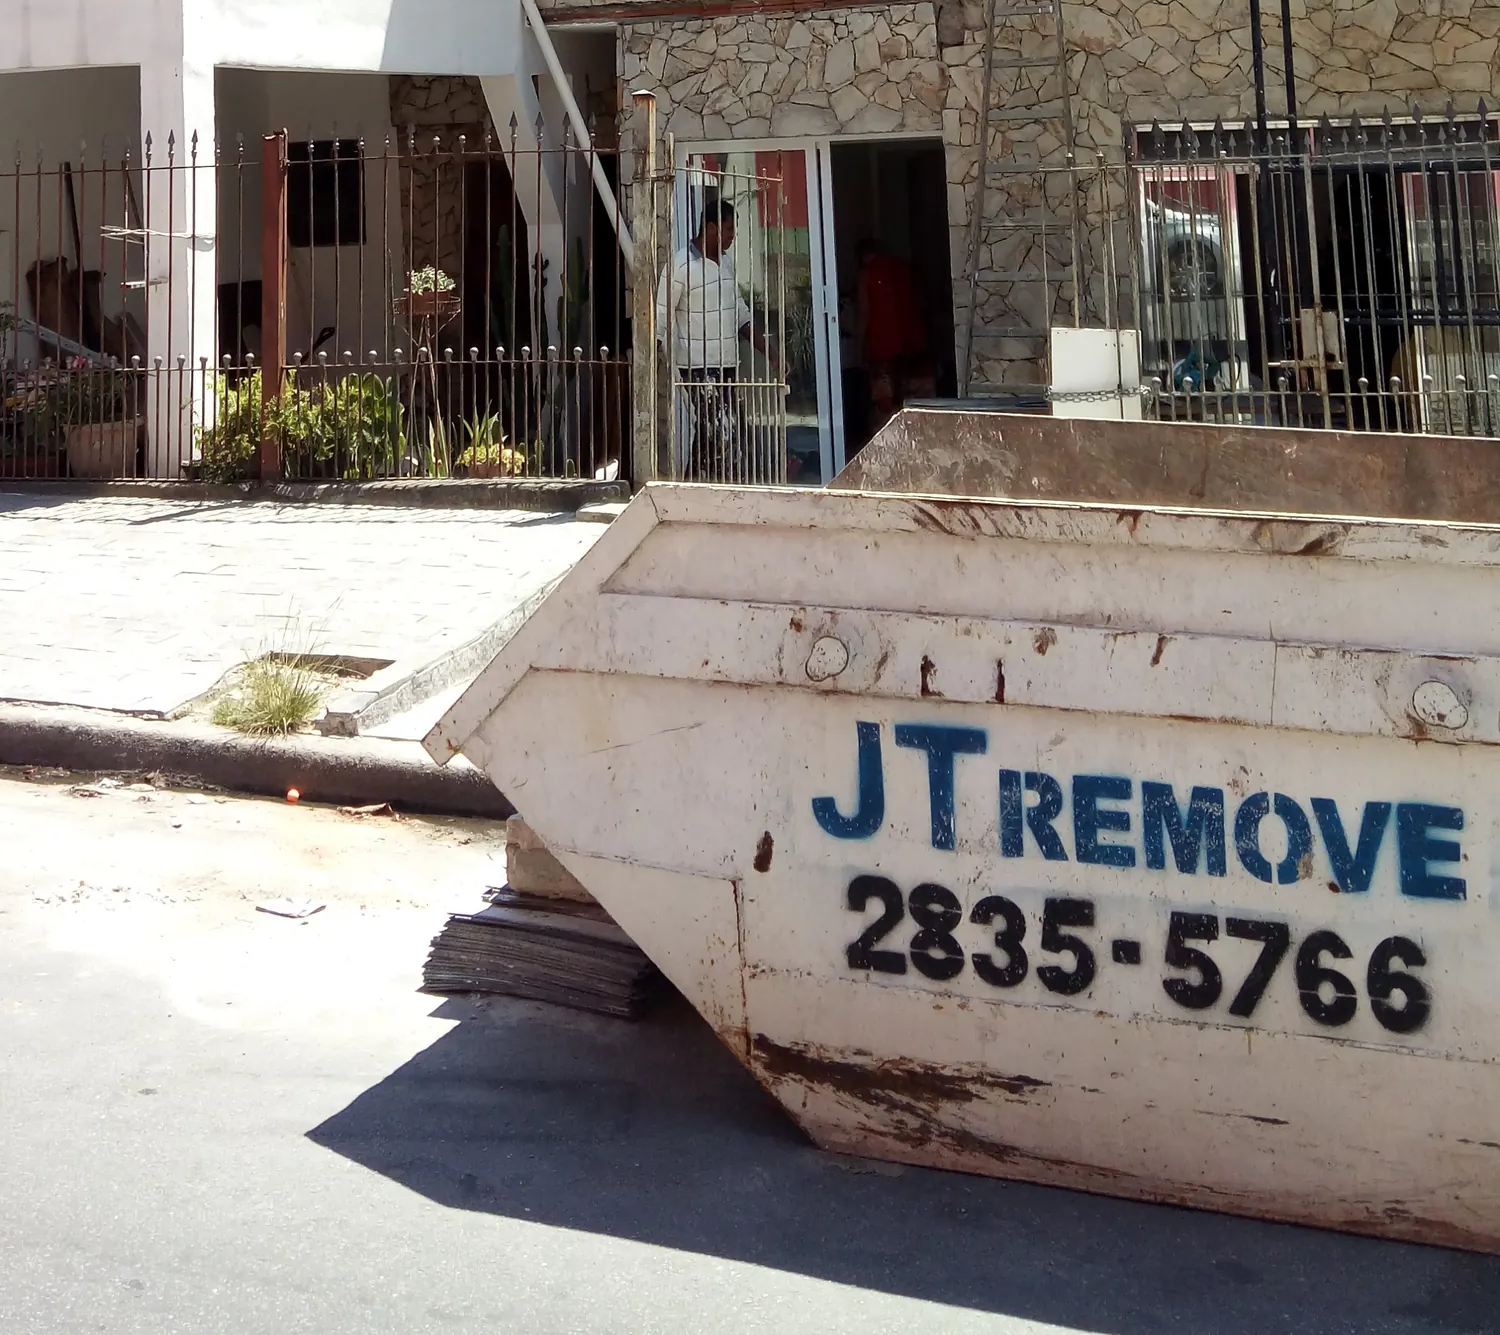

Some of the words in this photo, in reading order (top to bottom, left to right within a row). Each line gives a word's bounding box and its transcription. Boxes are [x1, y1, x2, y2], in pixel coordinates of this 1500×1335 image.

[812, 721, 987, 851] JT
[999, 770, 1467, 900] REMOVE
[846, 875, 1431, 1033] 2835-5766
